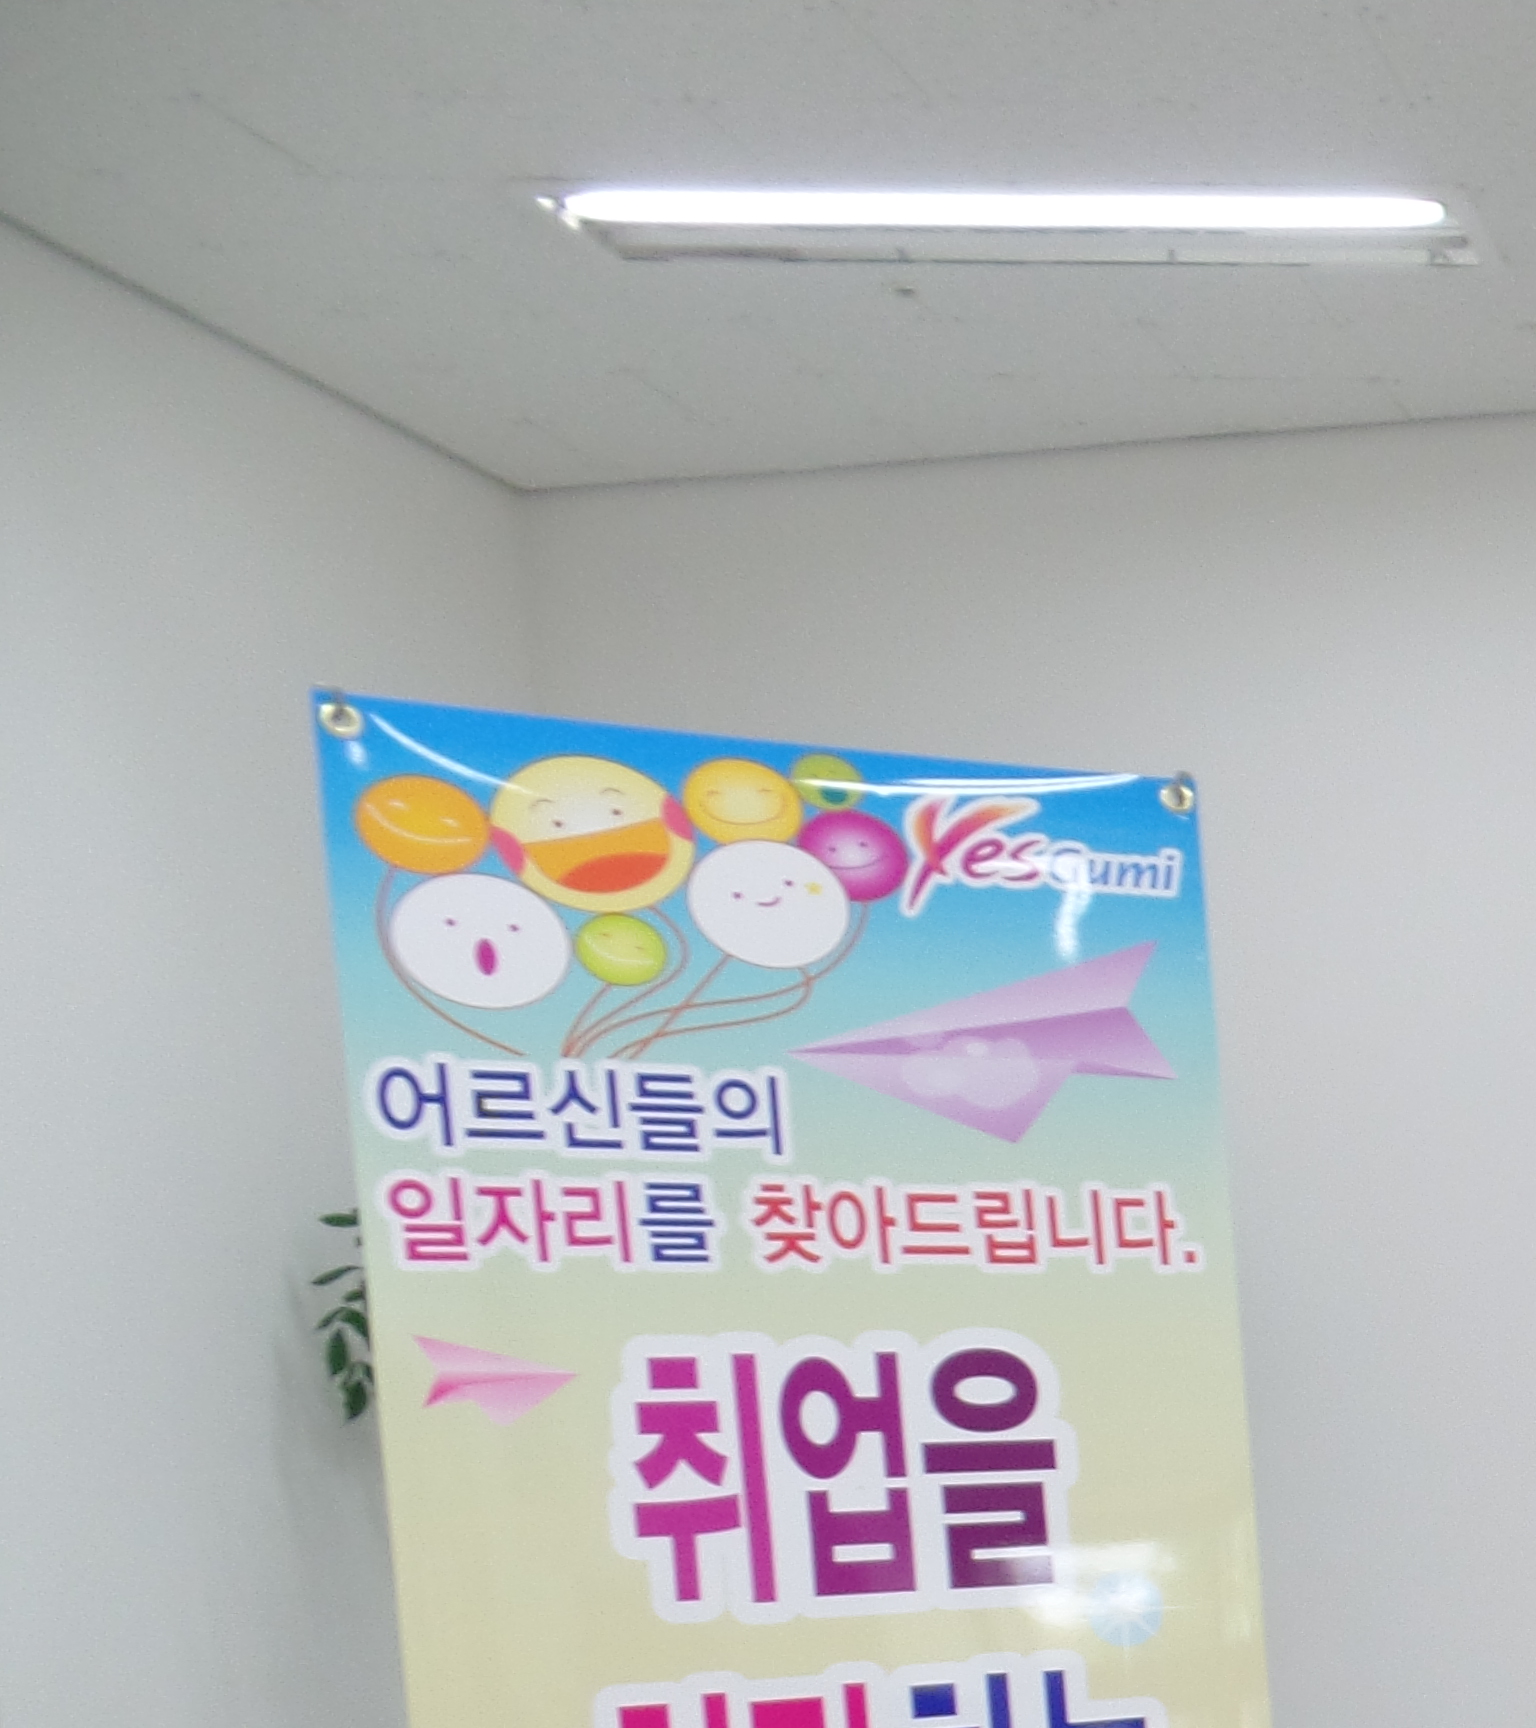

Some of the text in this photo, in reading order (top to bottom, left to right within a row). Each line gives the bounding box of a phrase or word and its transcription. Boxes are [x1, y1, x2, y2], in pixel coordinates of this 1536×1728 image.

[908, 799, 1041, 910] Yes
[377, 1062, 783, 1156] 어르신들의
[387, 1177, 1197, 1265] 일자리를 찾아드립니다.
[633, 1347, 1058, 1603] 취업을
